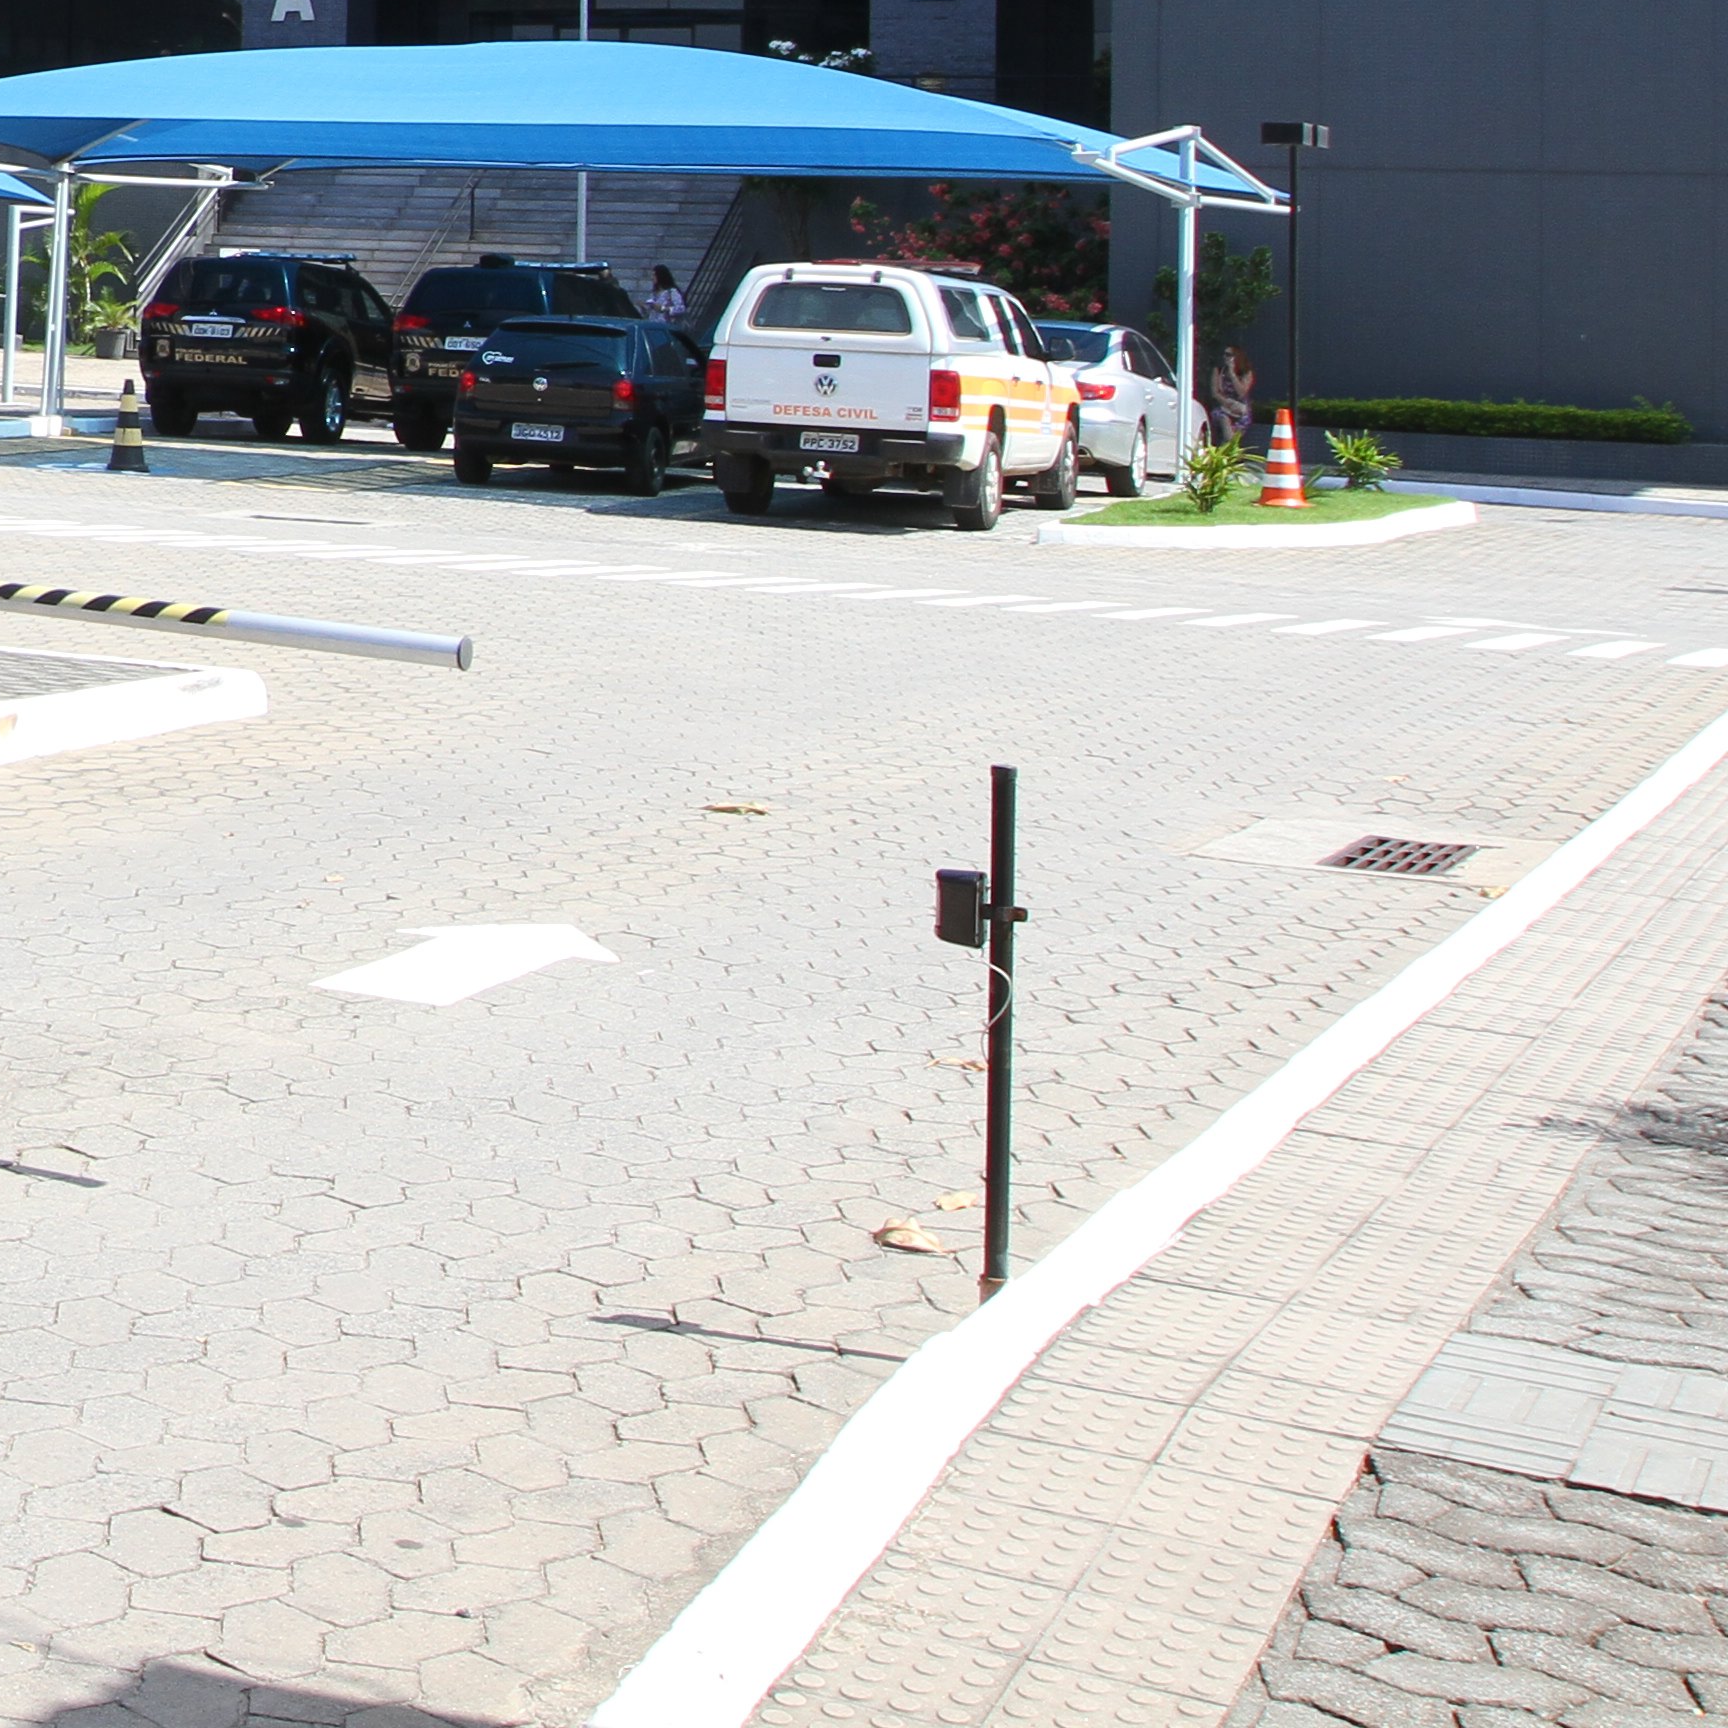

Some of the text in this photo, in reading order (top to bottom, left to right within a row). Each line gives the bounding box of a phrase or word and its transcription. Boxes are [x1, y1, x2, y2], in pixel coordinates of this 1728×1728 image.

[175, 353, 248, 365] FEDERAL
[772, 404, 878, 420] DEFESA CIVIL
